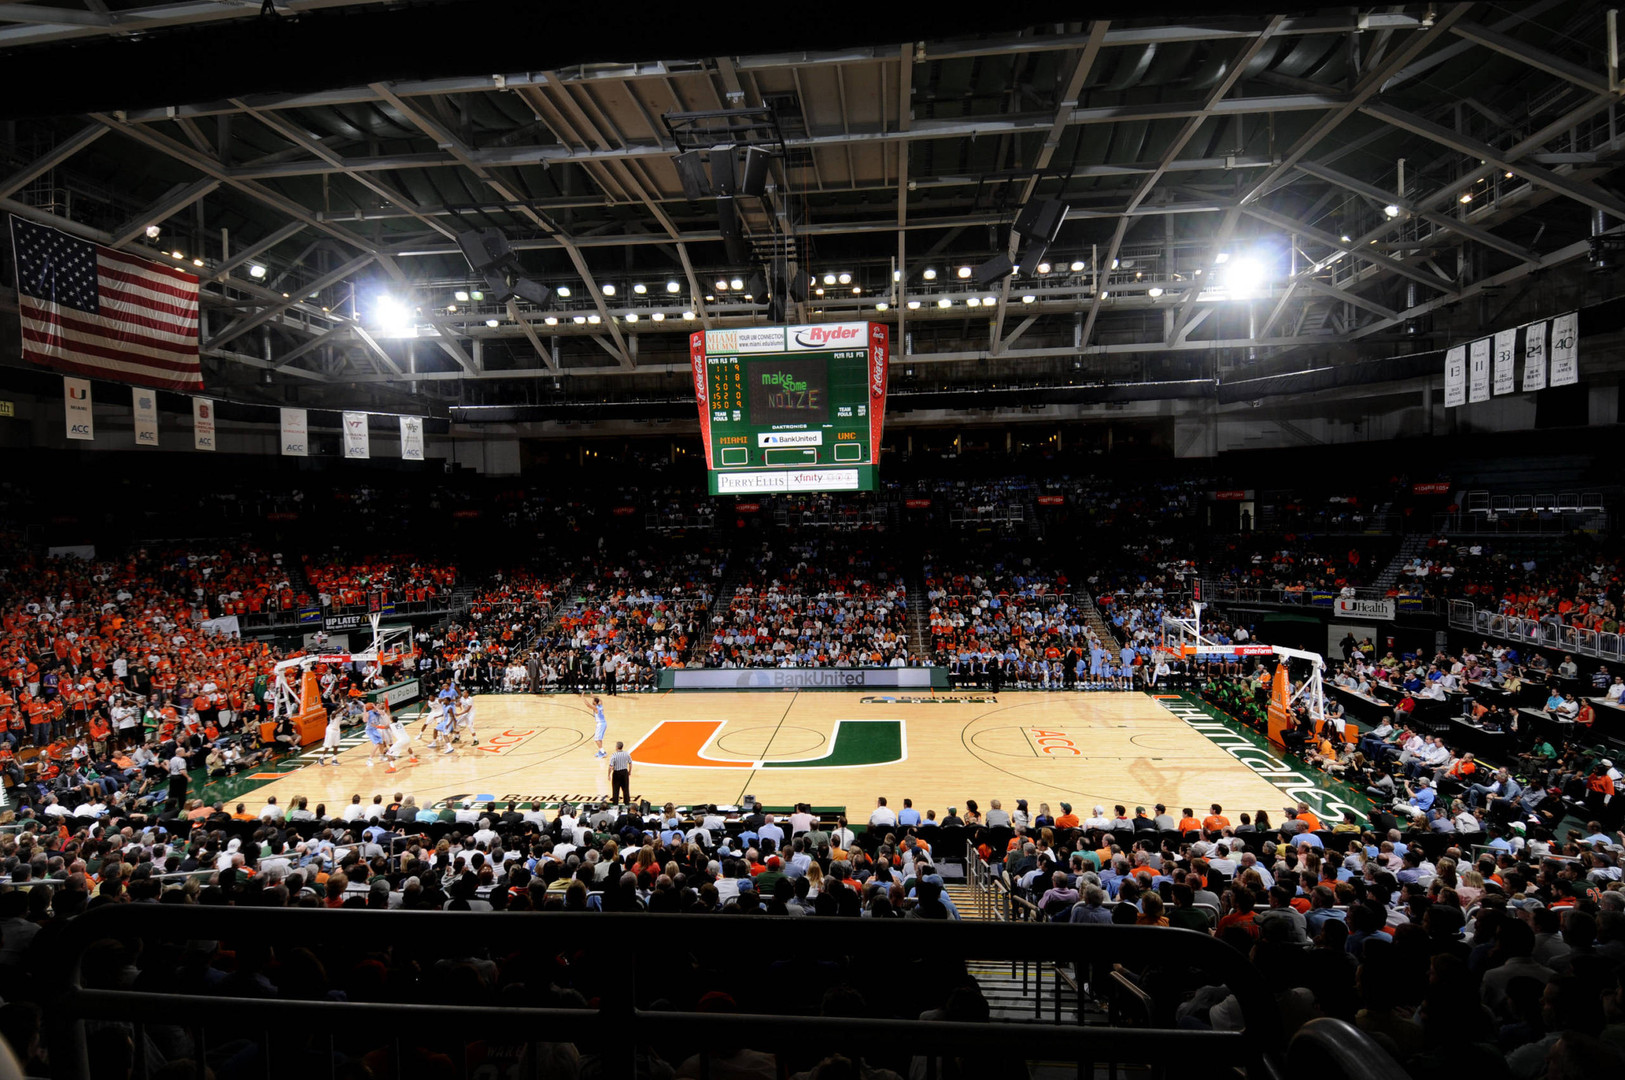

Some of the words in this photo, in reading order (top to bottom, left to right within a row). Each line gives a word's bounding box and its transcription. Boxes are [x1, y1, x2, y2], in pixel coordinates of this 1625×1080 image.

[707, 333, 738, 344] MIAMI
[810, 326, 860, 343] Ryder
[1555, 337, 1574, 350] 40
[1499, 350, 1511, 363] 33
[1526, 345, 1542, 358] 24
[1451, 365, 1461, 377] 13
[1475, 360, 1483, 372] 11
[762, 370, 793, 385] make
[782, 381, 807, 392] some
[71, 425, 89, 434] ACC
[139, 431, 154, 441] ACC
[199, 437, 212, 446] ACC
[719, 436, 748, 445] MIAMI
[837, 432, 856, 440] UNC
[286, 444, 304, 452] ACC
[350, 447, 365, 455] ACC
[721, 475, 755, 487] PERRY
[756, 474, 785, 487] ELLIS
[794, 473, 823, 483] xfinity
[325, 618, 337, 626] UP
[337, 615, 360, 625] LATE?
[774, 670, 865, 686] BankUnited
[477, 729, 536, 753] ACC
[1030, 728, 1083, 757] ACC
